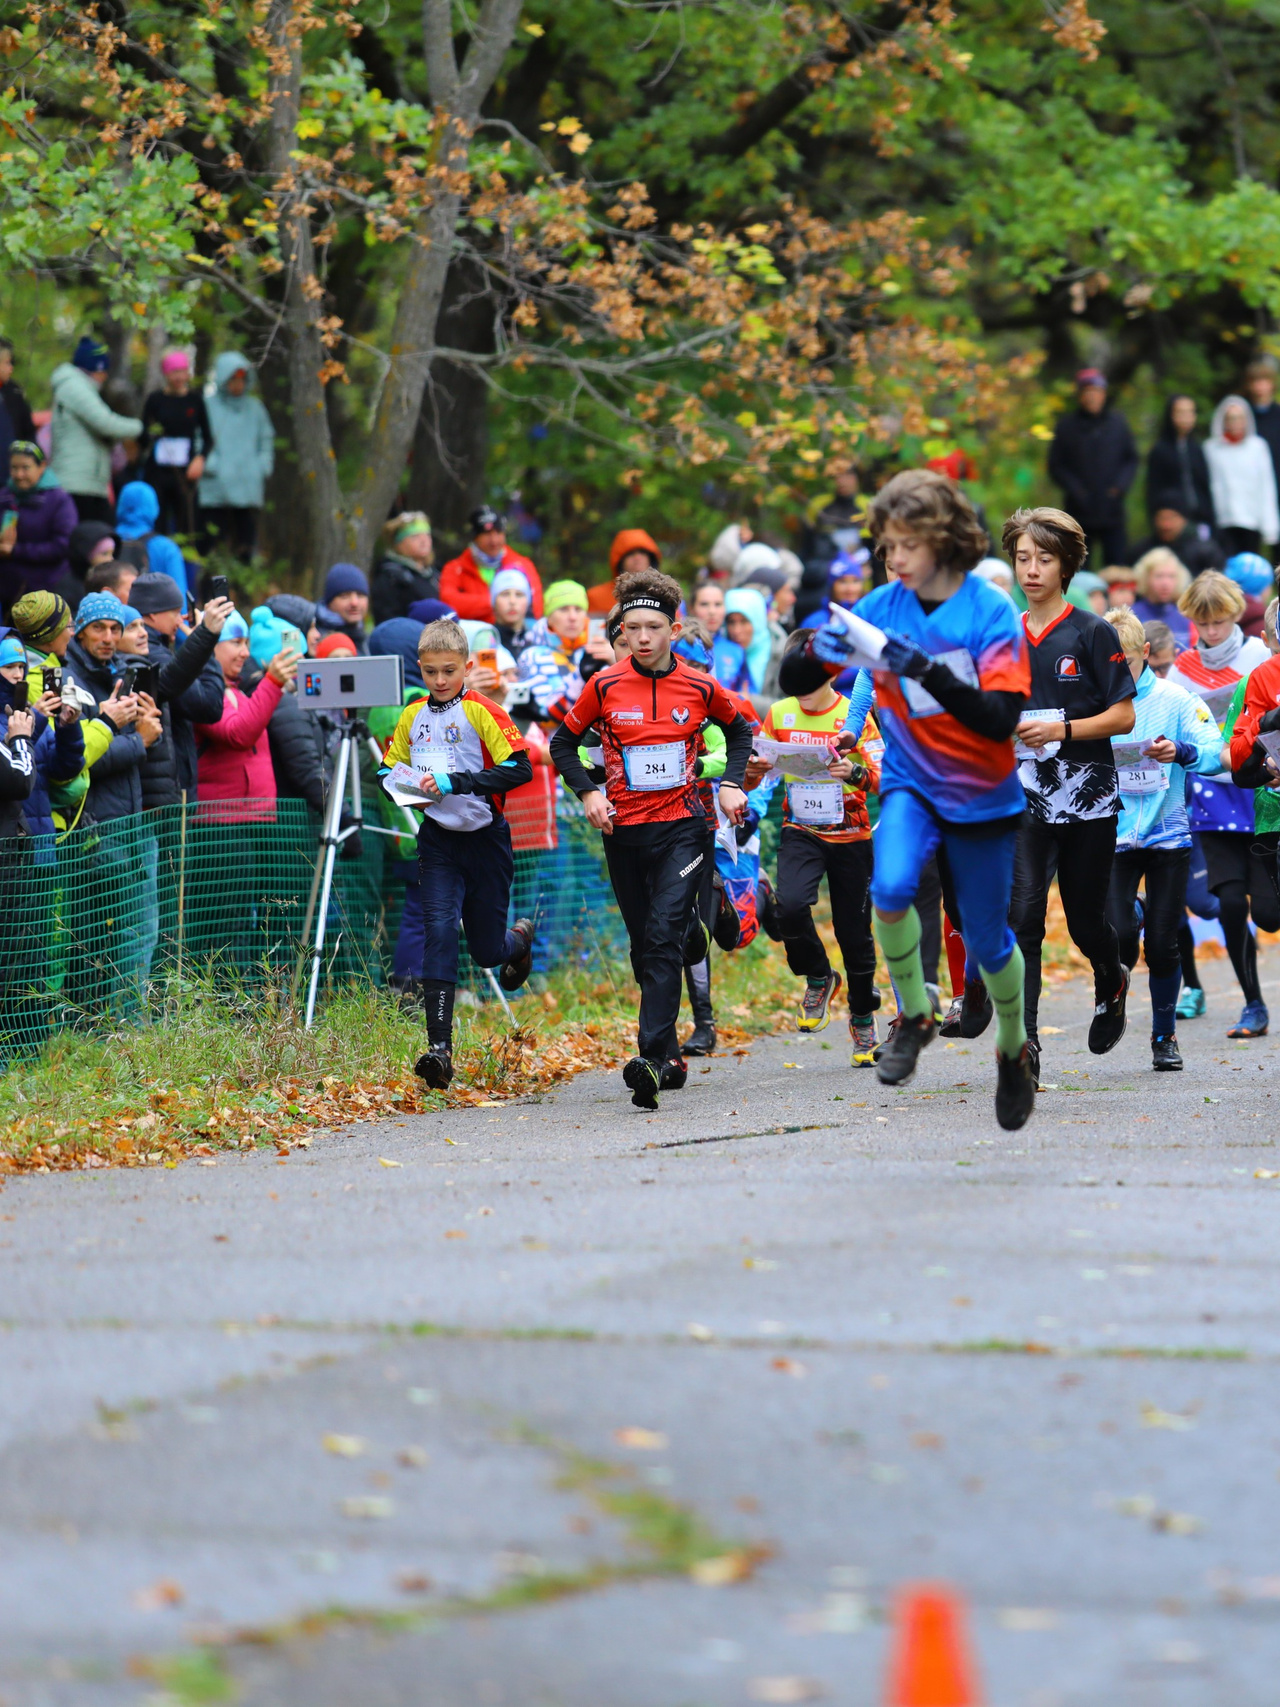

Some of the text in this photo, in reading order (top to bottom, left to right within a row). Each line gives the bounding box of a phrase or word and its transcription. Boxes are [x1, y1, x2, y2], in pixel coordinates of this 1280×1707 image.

[622, 599, 661, 611] noname
[611, 719, 635, 727] Обухов
[645, 763, 667, 775] 284
[1128, 771, 1147, 781] 281
[804, 799, 823, 809] 294
[679, 852, 704, 878] noname
